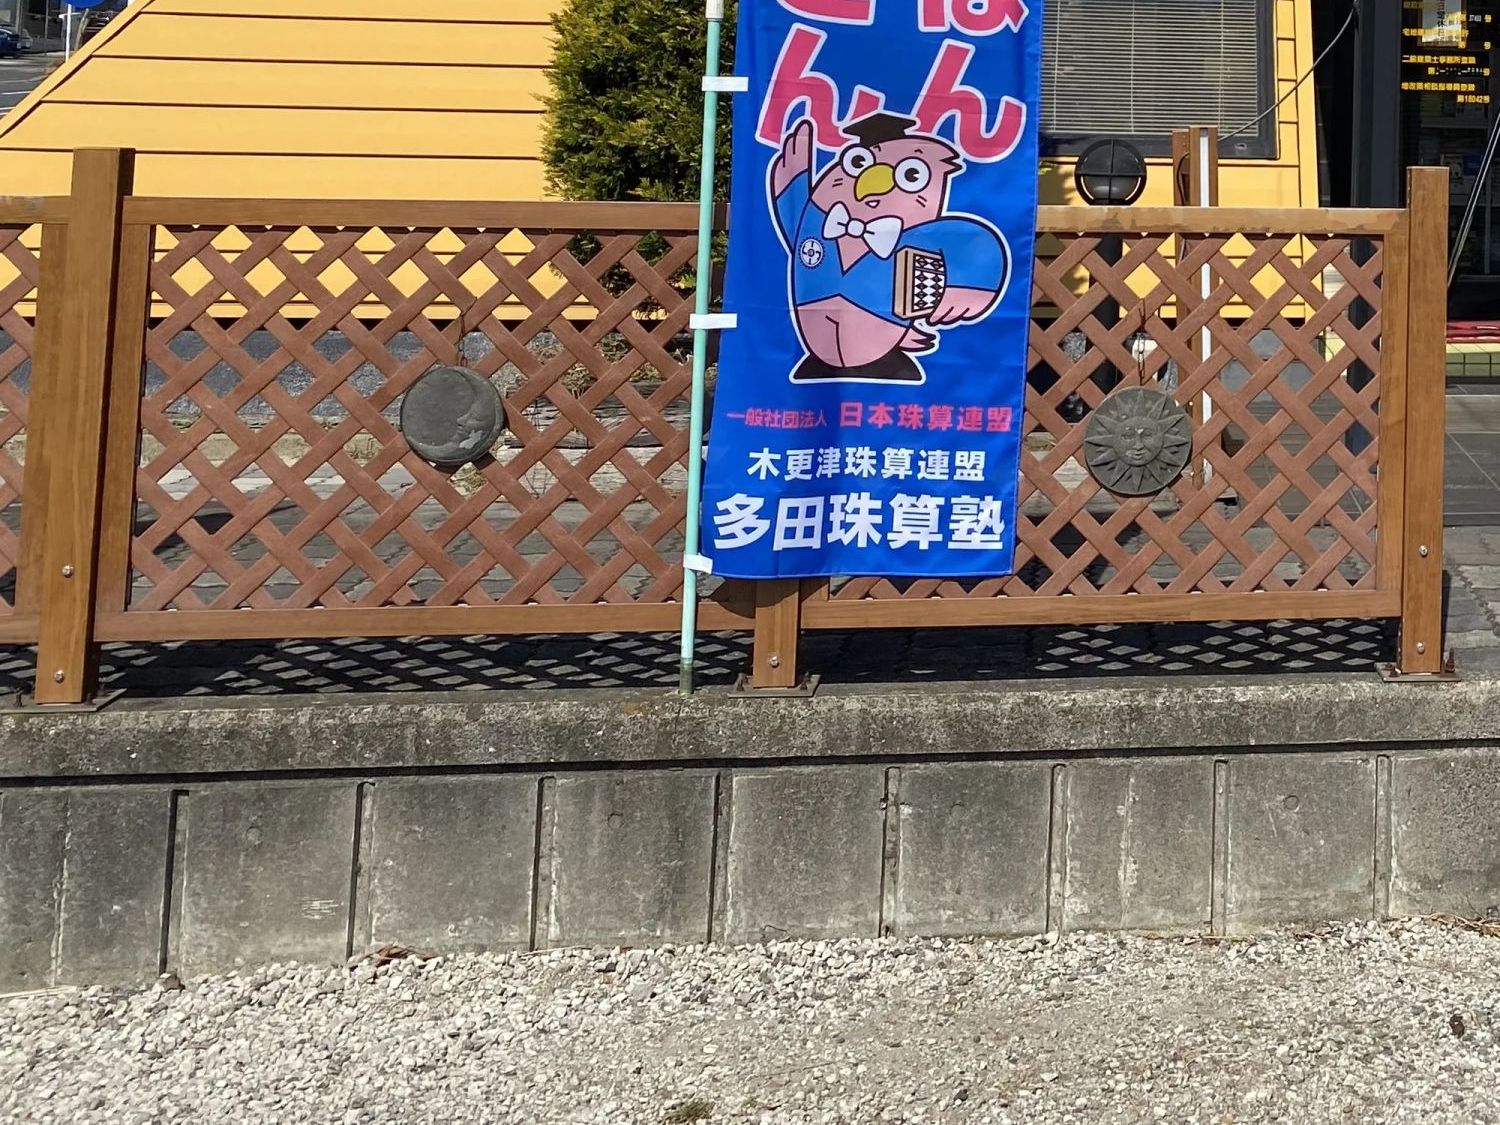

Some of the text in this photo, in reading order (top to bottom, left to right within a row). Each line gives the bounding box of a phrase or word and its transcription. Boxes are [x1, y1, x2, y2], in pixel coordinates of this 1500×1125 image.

[727, 401, 1013, 432] 一般社団法人 日本珠算連盟
[747, 446, 987, 481] 木更津珠算連盟
[713, 492, 1006, 551] 多田珠算塾
